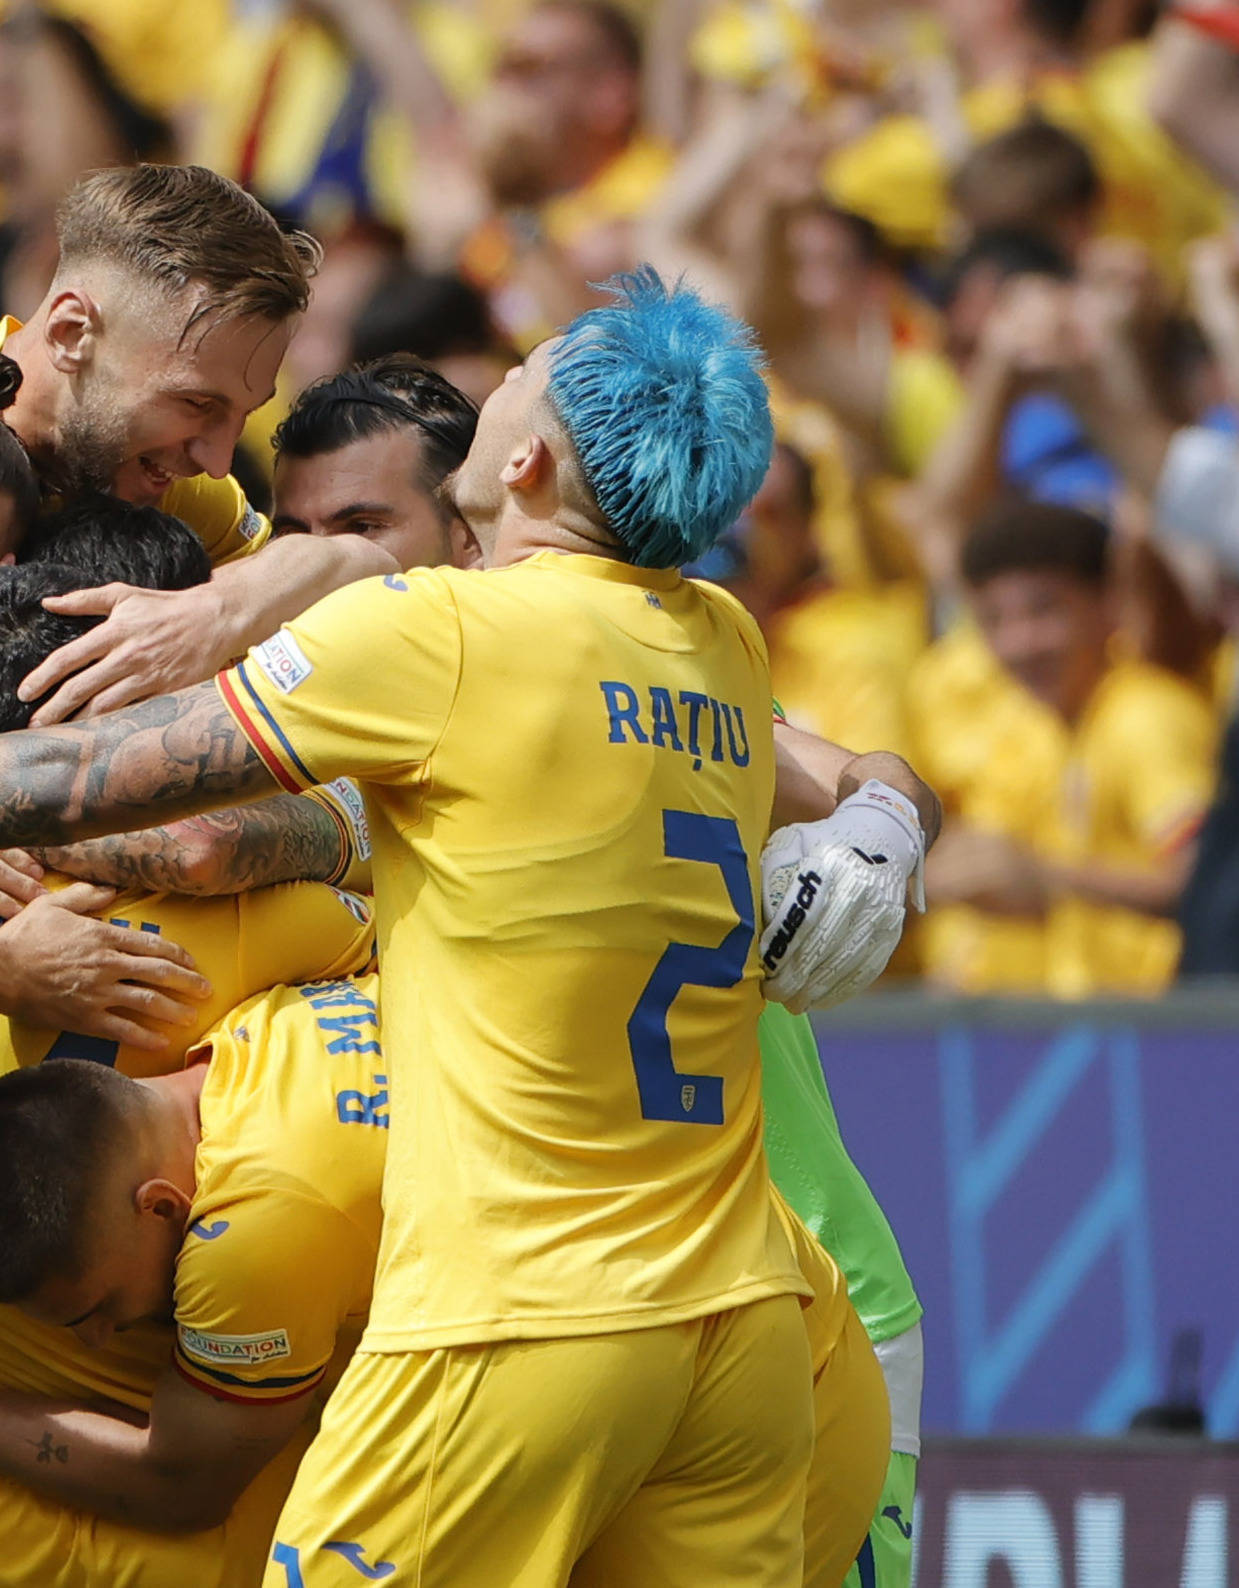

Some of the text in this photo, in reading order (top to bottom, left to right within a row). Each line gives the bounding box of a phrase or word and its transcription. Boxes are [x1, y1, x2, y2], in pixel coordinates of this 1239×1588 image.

[599, 681, 750, 771] RAȚIU
[627, 808, 755, 1126] 2
[763, 869, 822, 971] reusch
